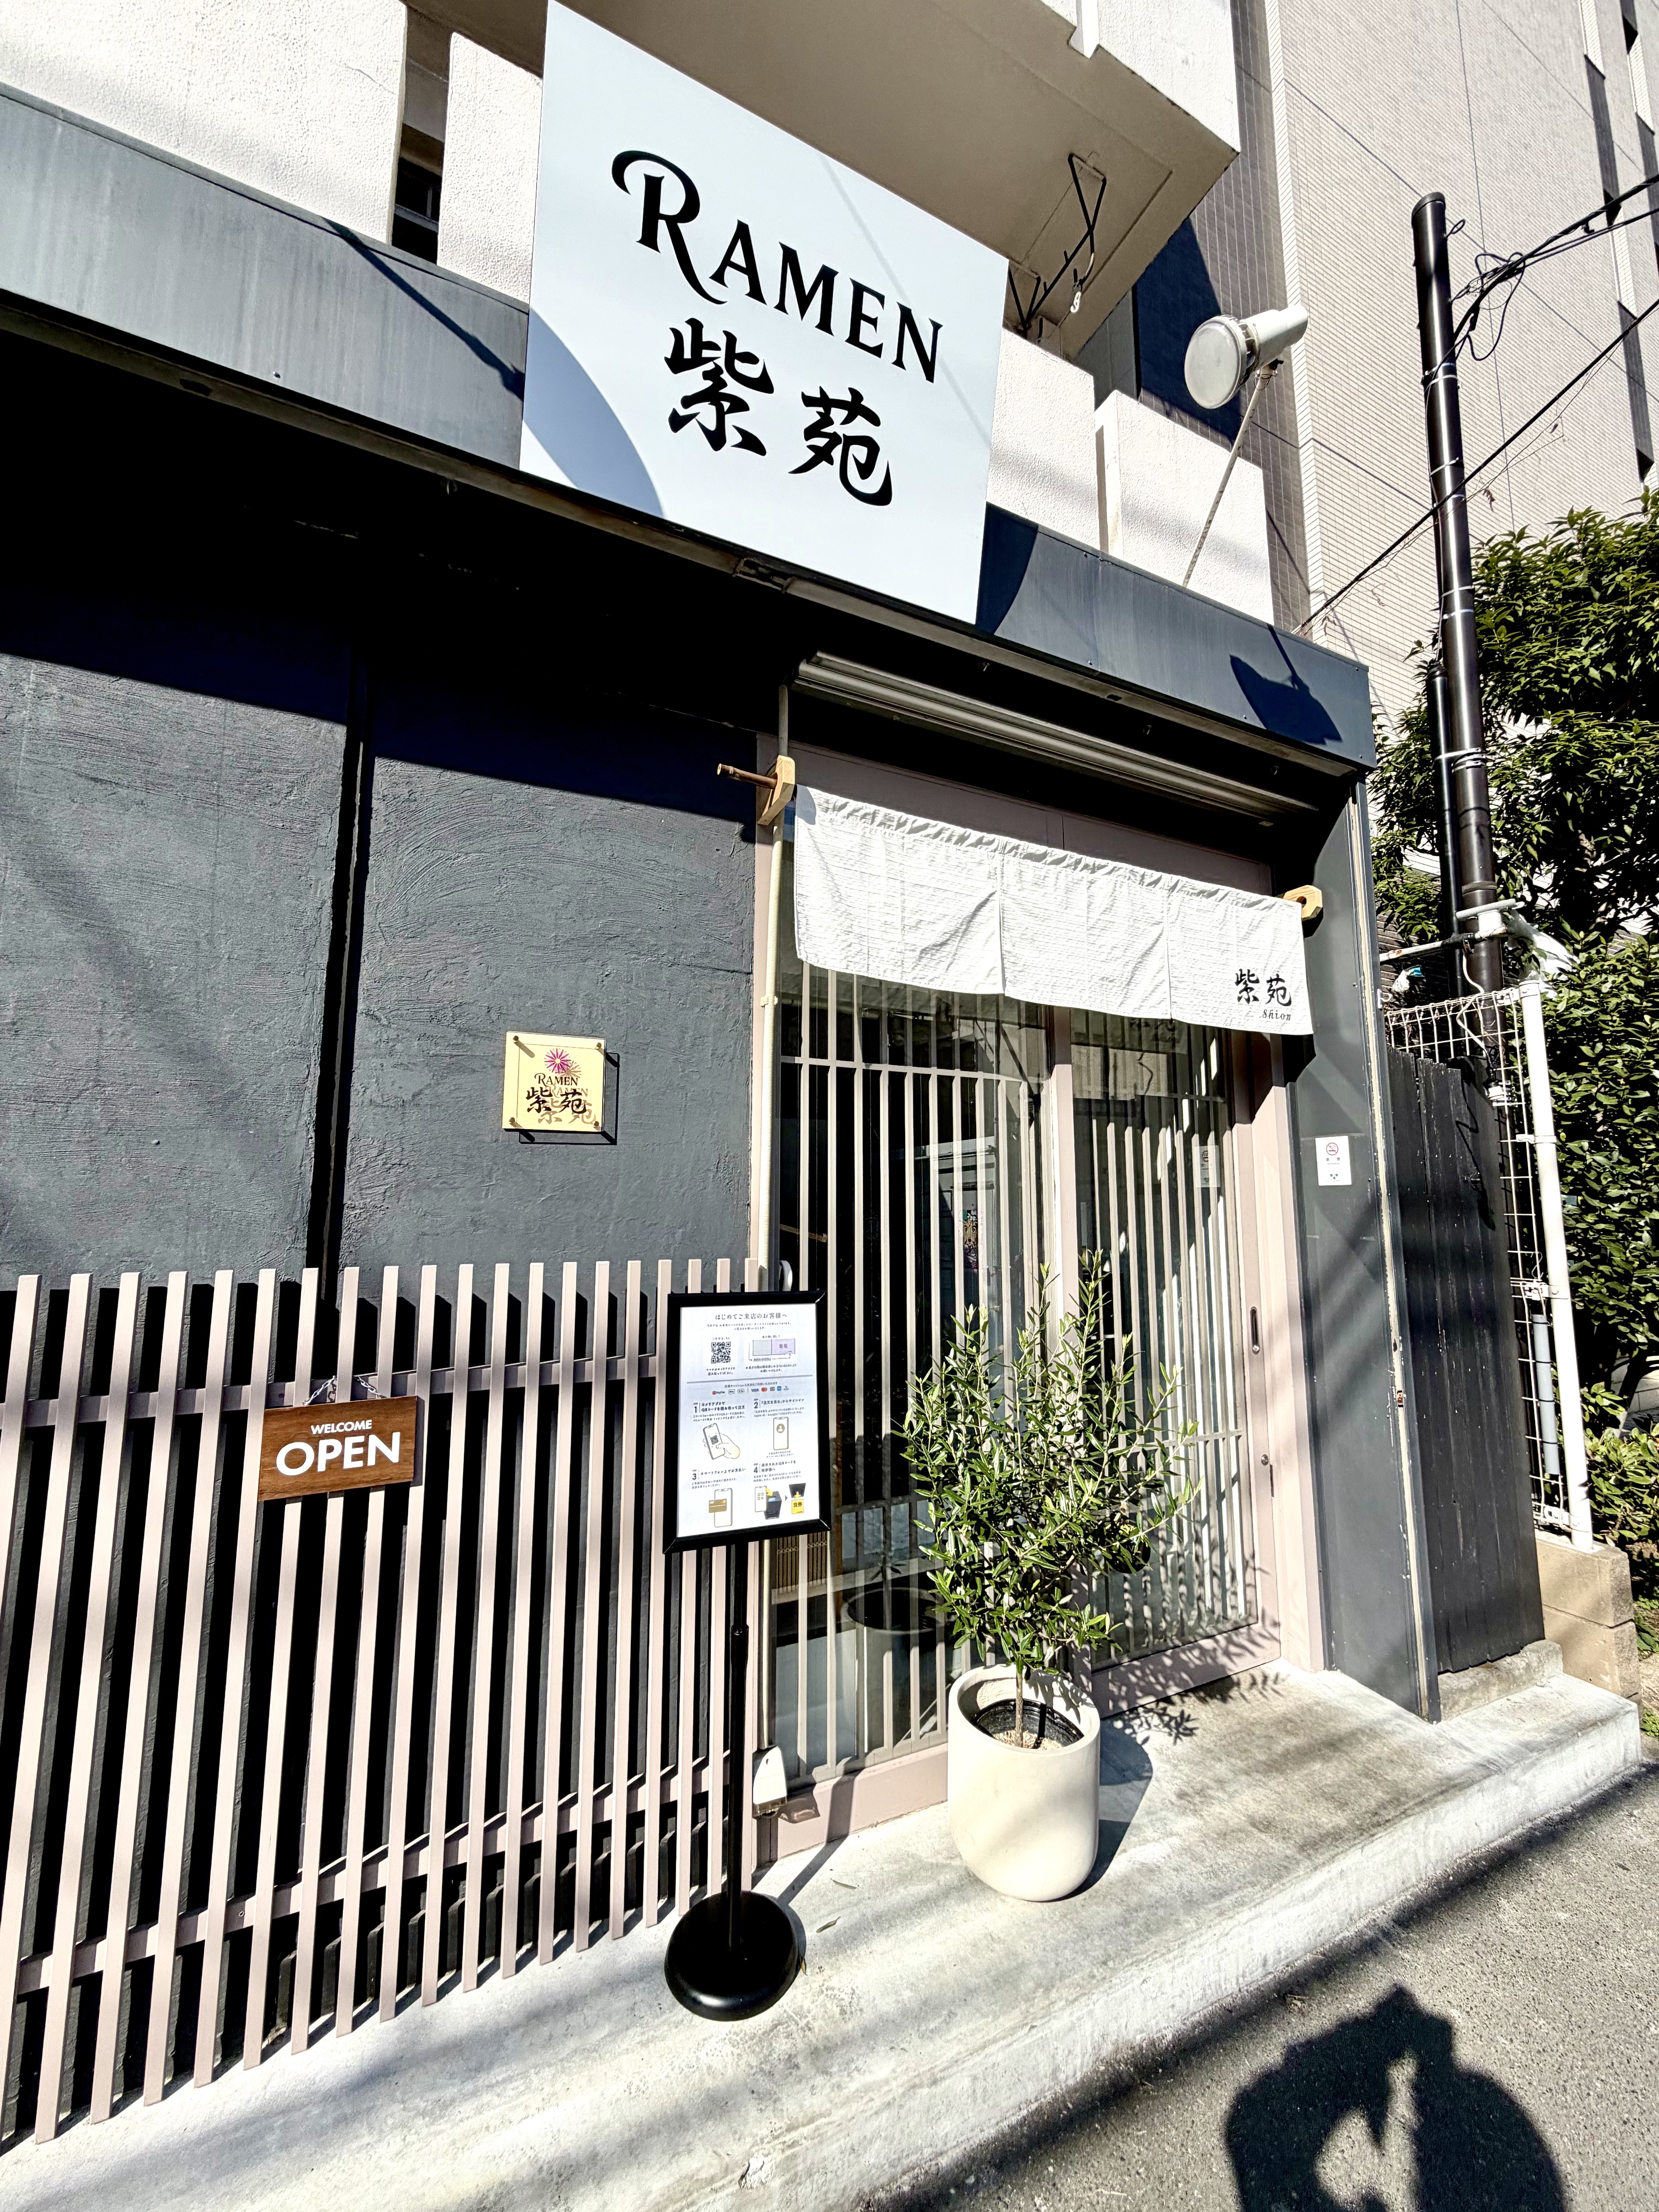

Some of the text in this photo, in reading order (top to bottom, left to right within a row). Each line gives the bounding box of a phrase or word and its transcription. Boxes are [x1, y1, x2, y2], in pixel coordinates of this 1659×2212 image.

[611, 150, 943, 383] RAMEN
[664, 317, 893, 507] 紫苑
[1234, 968, 1292, 1006] 紫苑
[1262, 1009, 1291, 1021] Shion
[534, 1072, 579, 1086] RAMEN
[525, 1086, 587, 1114] 紫苑
[311, 1419, 373, 1435] WELCOME
[276, 1431, 401, 1476] OPEN
